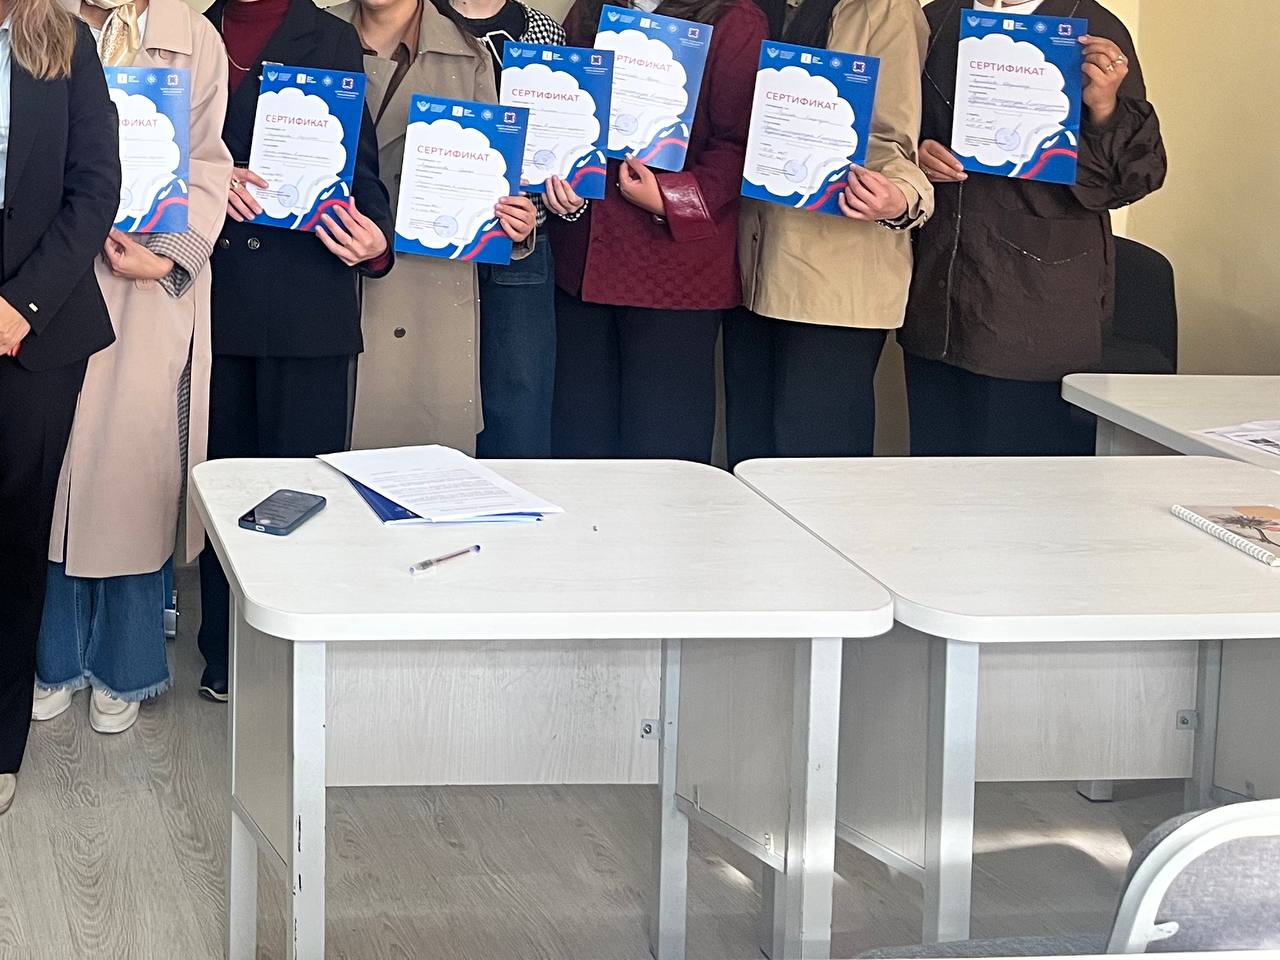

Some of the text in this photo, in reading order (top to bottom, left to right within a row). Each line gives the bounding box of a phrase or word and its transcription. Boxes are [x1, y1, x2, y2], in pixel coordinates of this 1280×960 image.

[969, 60, 1046, 76] СЕРТИФИКАТ
[511, 88, 580, 102] СЕРТИФИКАТ
[766, 91, 839, 111] СЕРТИФИКАТ
[265, 114, 329, 128] СЕРТИФИКАТ
[417, 145, 490, 162] СЕРТИФИКАТ
